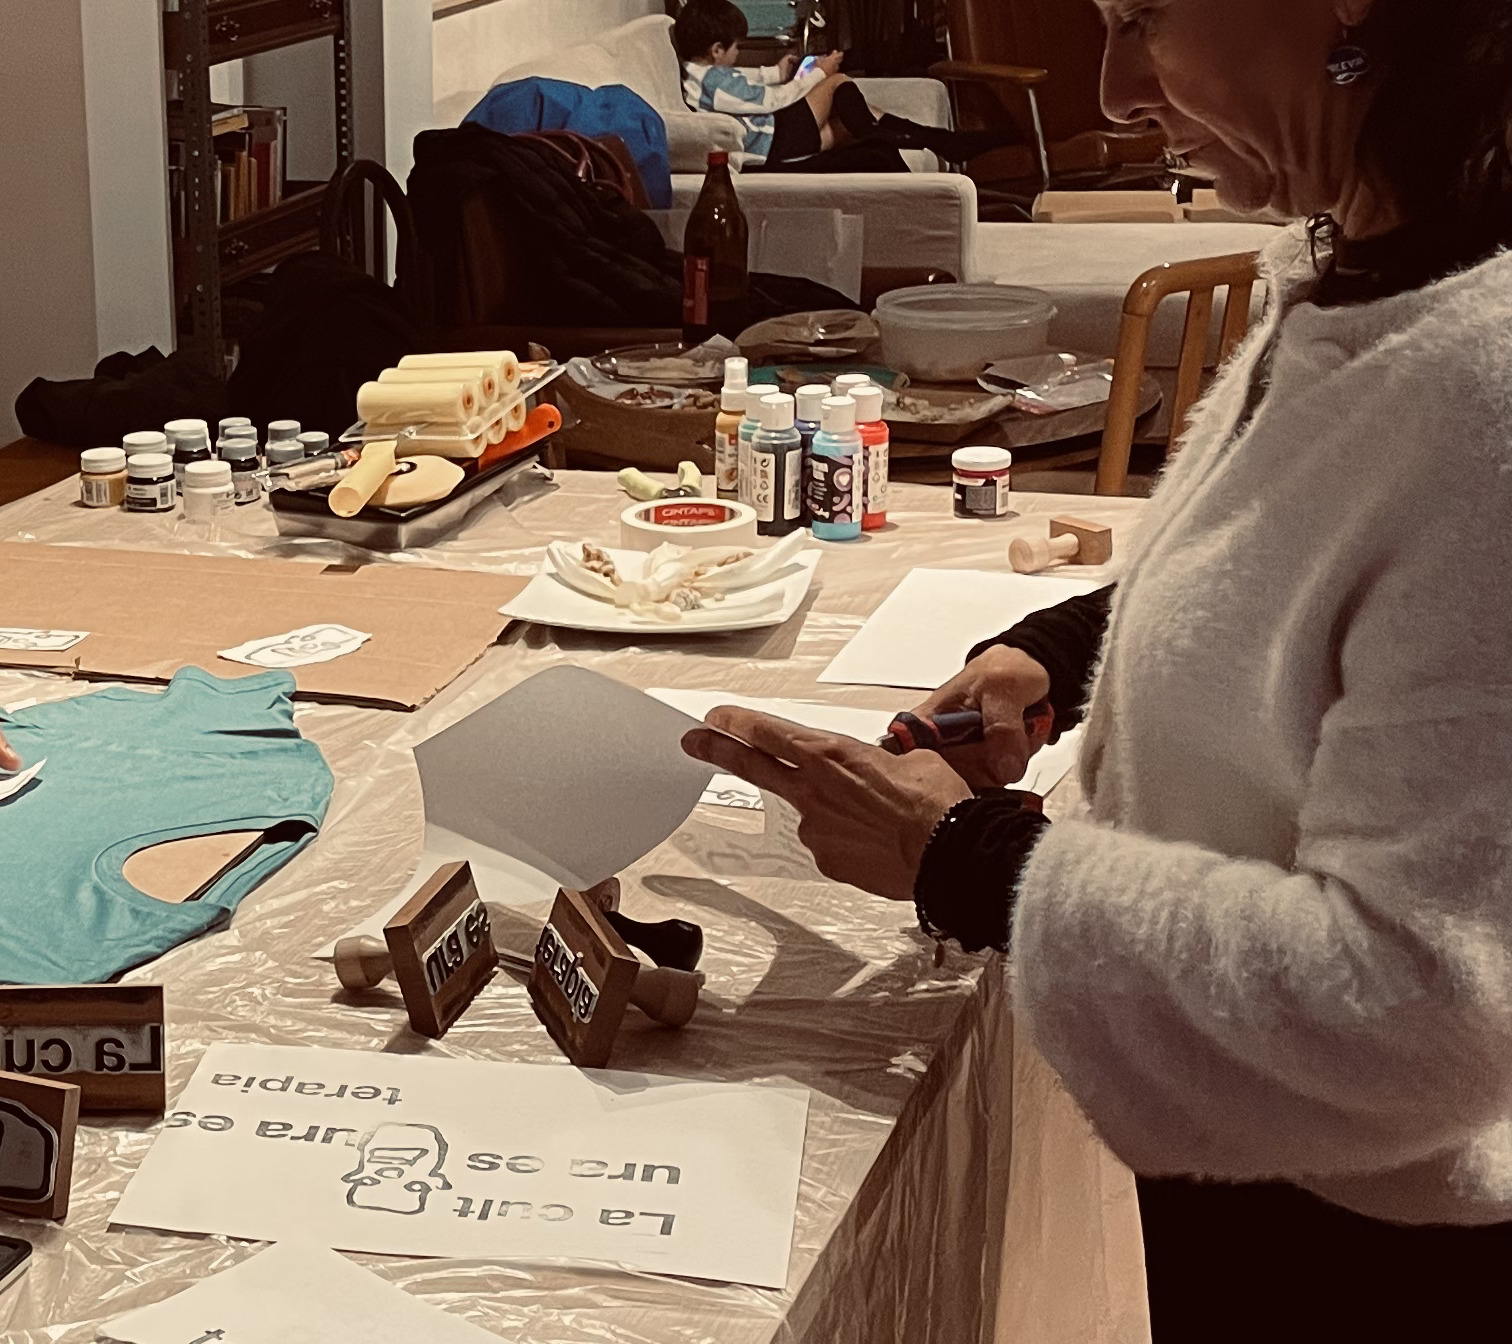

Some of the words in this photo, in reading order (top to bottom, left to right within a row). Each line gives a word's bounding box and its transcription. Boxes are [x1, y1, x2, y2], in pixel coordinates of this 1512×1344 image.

[209, 1071, 403, 1107] terapia
[163, 1109, 235, 1134] es
[255, 1118, 359, 1149] ura
[464, 1150, 545, 1178] es
[569, 1157, 682, 1186] ura
[450, 1195, 575, 1226] cult
[598, 1207, 676, 1236] La
